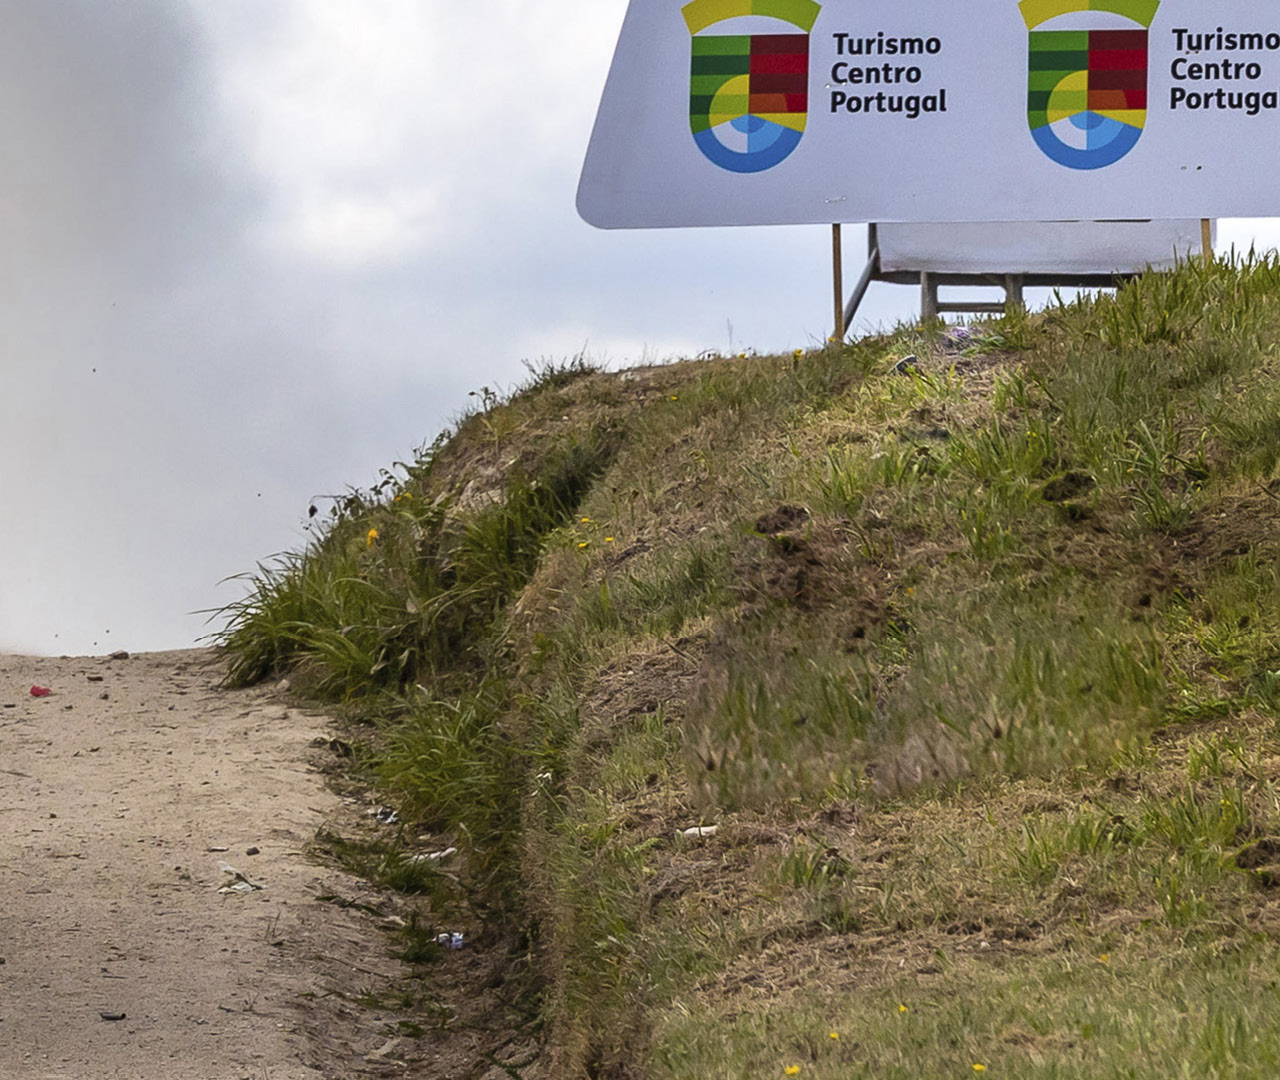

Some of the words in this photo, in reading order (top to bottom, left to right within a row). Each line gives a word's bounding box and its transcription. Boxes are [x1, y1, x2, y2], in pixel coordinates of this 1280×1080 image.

[832, 32, 942, 56] Turismo
[1171, 26, 1280, 51] Turismo
[831, 62, 922, 85] Centro
[1170, 58, 1262, 81] Centro
[829, 89, 947, 118] Portugal
[1169, 87, 1278, 116] Portuga
